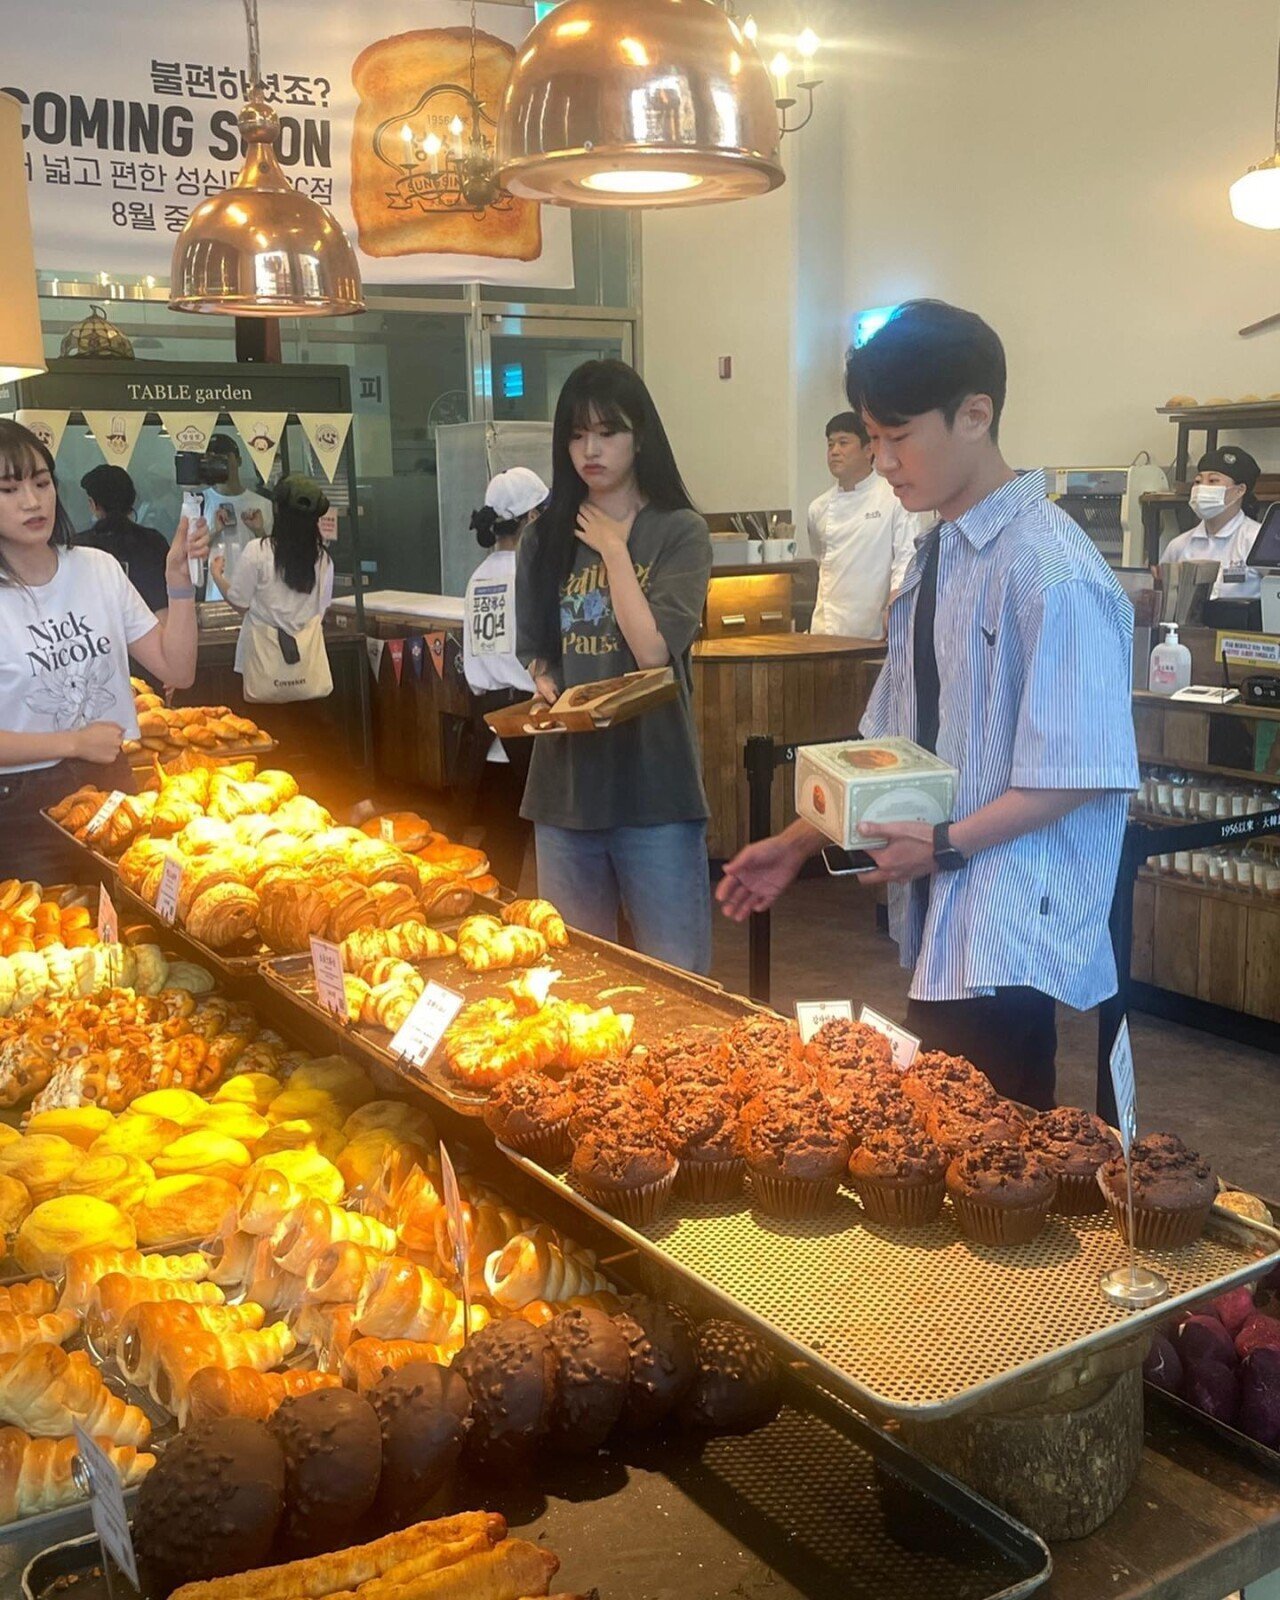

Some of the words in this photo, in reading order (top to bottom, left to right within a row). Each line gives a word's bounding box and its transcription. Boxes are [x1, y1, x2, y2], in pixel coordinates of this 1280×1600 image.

[150, 59, 331, 107] 불편하셨죠?
[208, 109, 332, 168] SON
[43, 154, 102, 187] 넓고
[110, 160, 168, 194] 편한
[112, 201, 157, 231] 8월
[127, 384, 192, 400] TABLE
[195, 384, 252, 404] garden
[26, 611, 93, 649] Nick
[25, 633, 112, 677] Nicole
